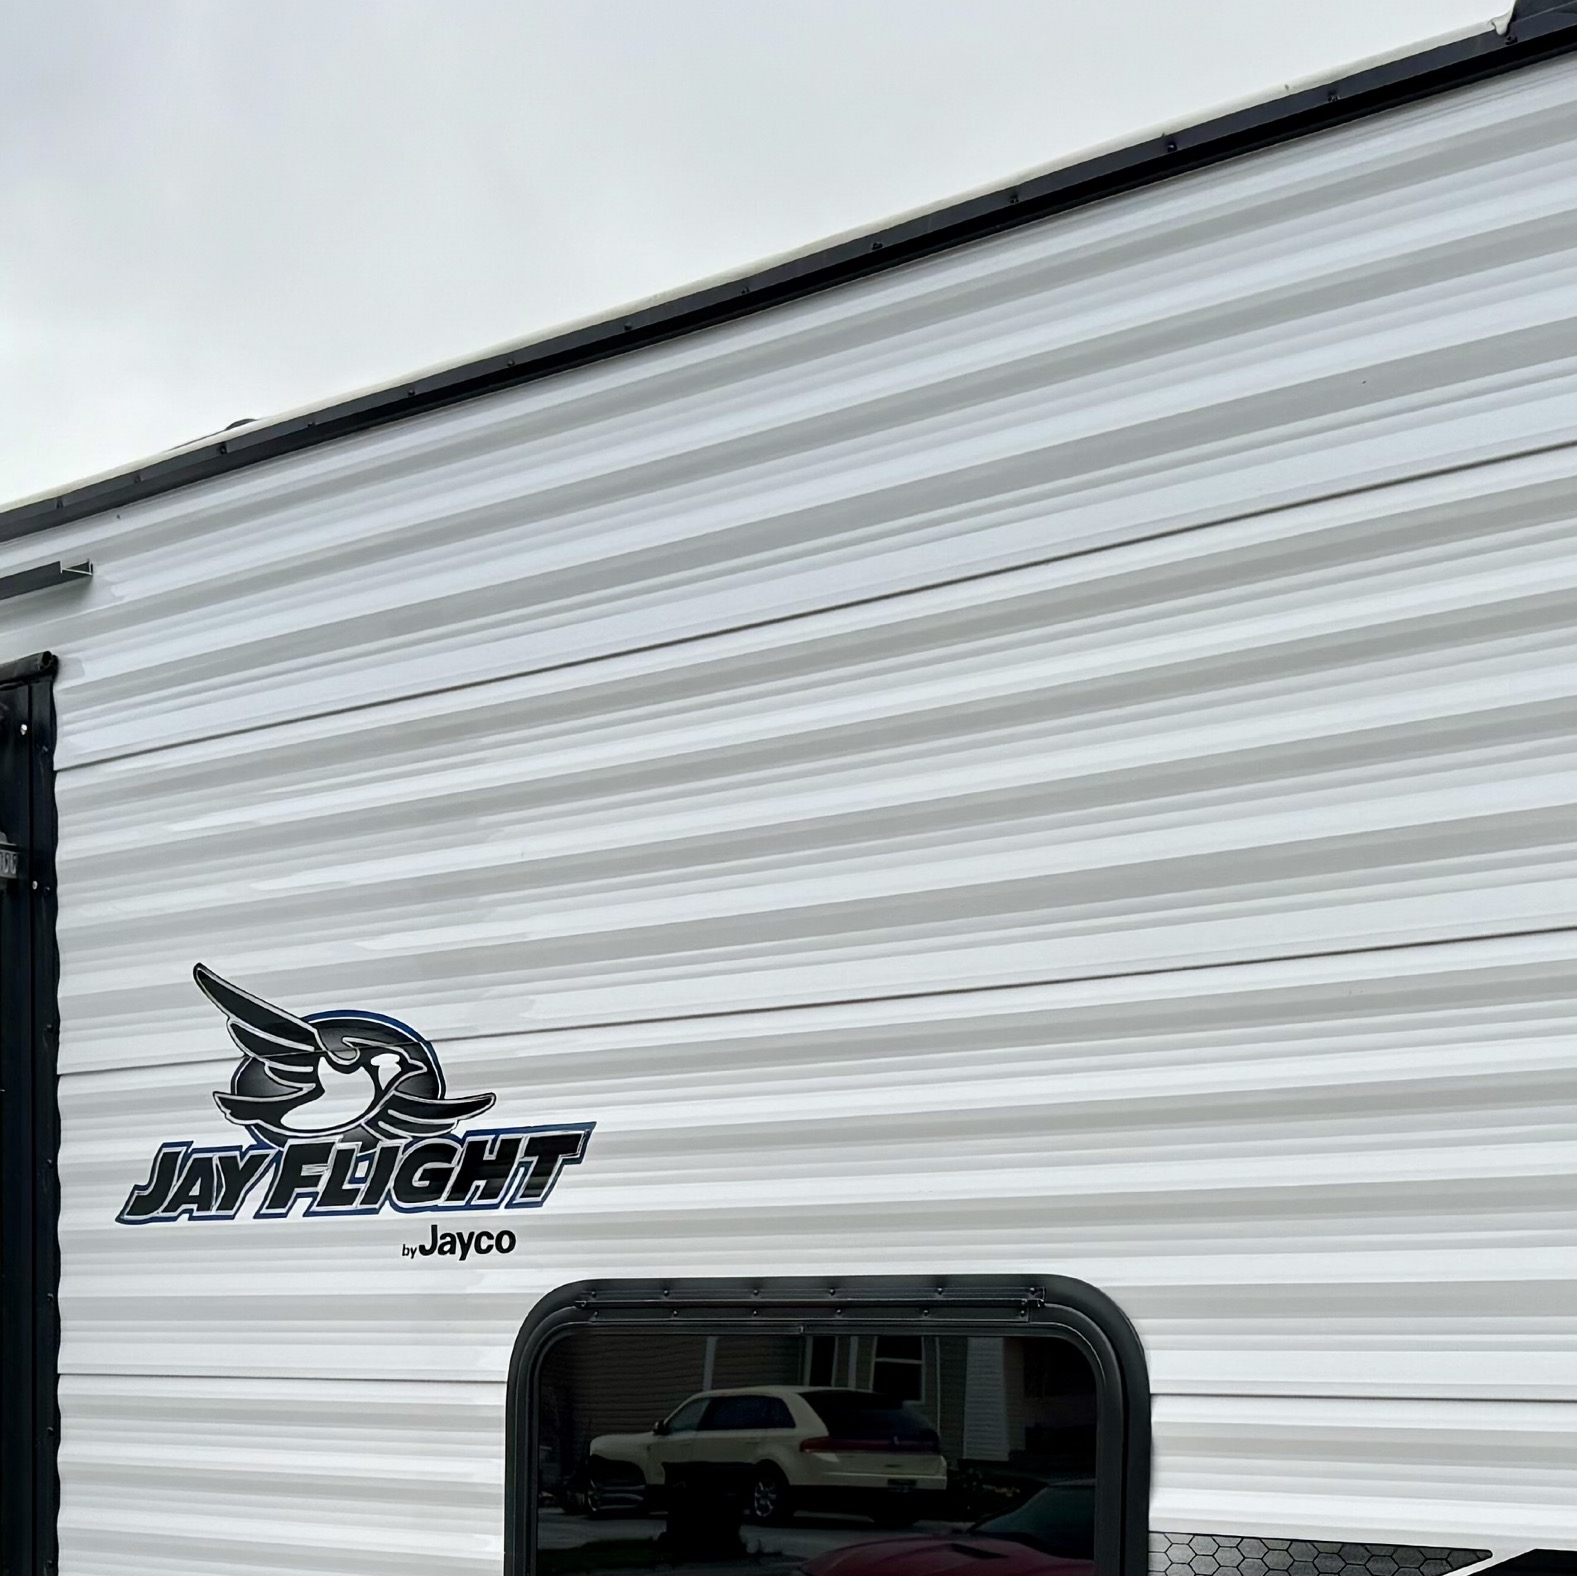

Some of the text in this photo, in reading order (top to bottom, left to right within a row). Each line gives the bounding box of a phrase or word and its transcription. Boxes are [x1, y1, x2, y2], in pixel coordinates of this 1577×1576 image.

[115, 1120, 597, 1225] JAY FLIGHT
[401, 1224, 517, 1262] by Jayco
